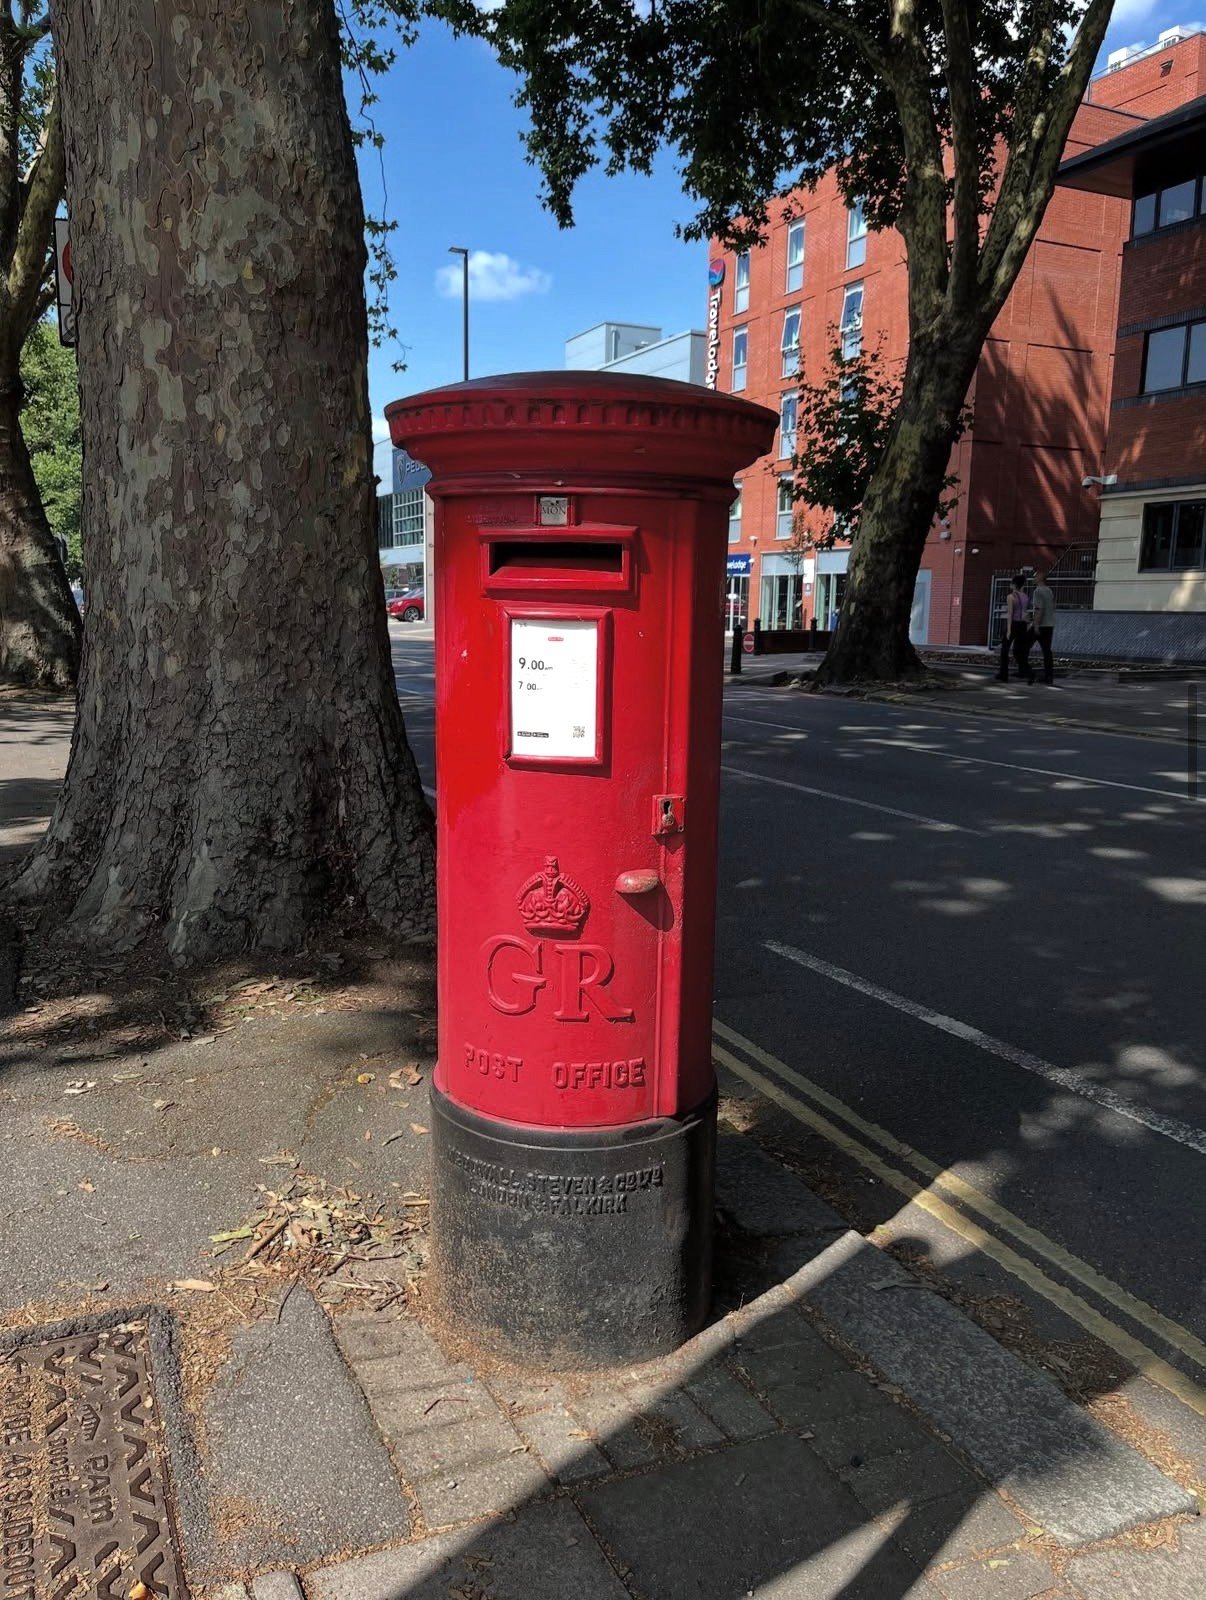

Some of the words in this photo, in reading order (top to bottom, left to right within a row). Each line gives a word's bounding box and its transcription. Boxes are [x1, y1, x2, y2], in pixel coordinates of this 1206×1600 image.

[541, 505, 567, 515] MON
[481, 933, 637, 1024] GR
[463, 1041, 524, 1083] POST
[551, 1057, 647, 1090] OFFICE
[549, 1192, 628, 1216] FALKIRK
